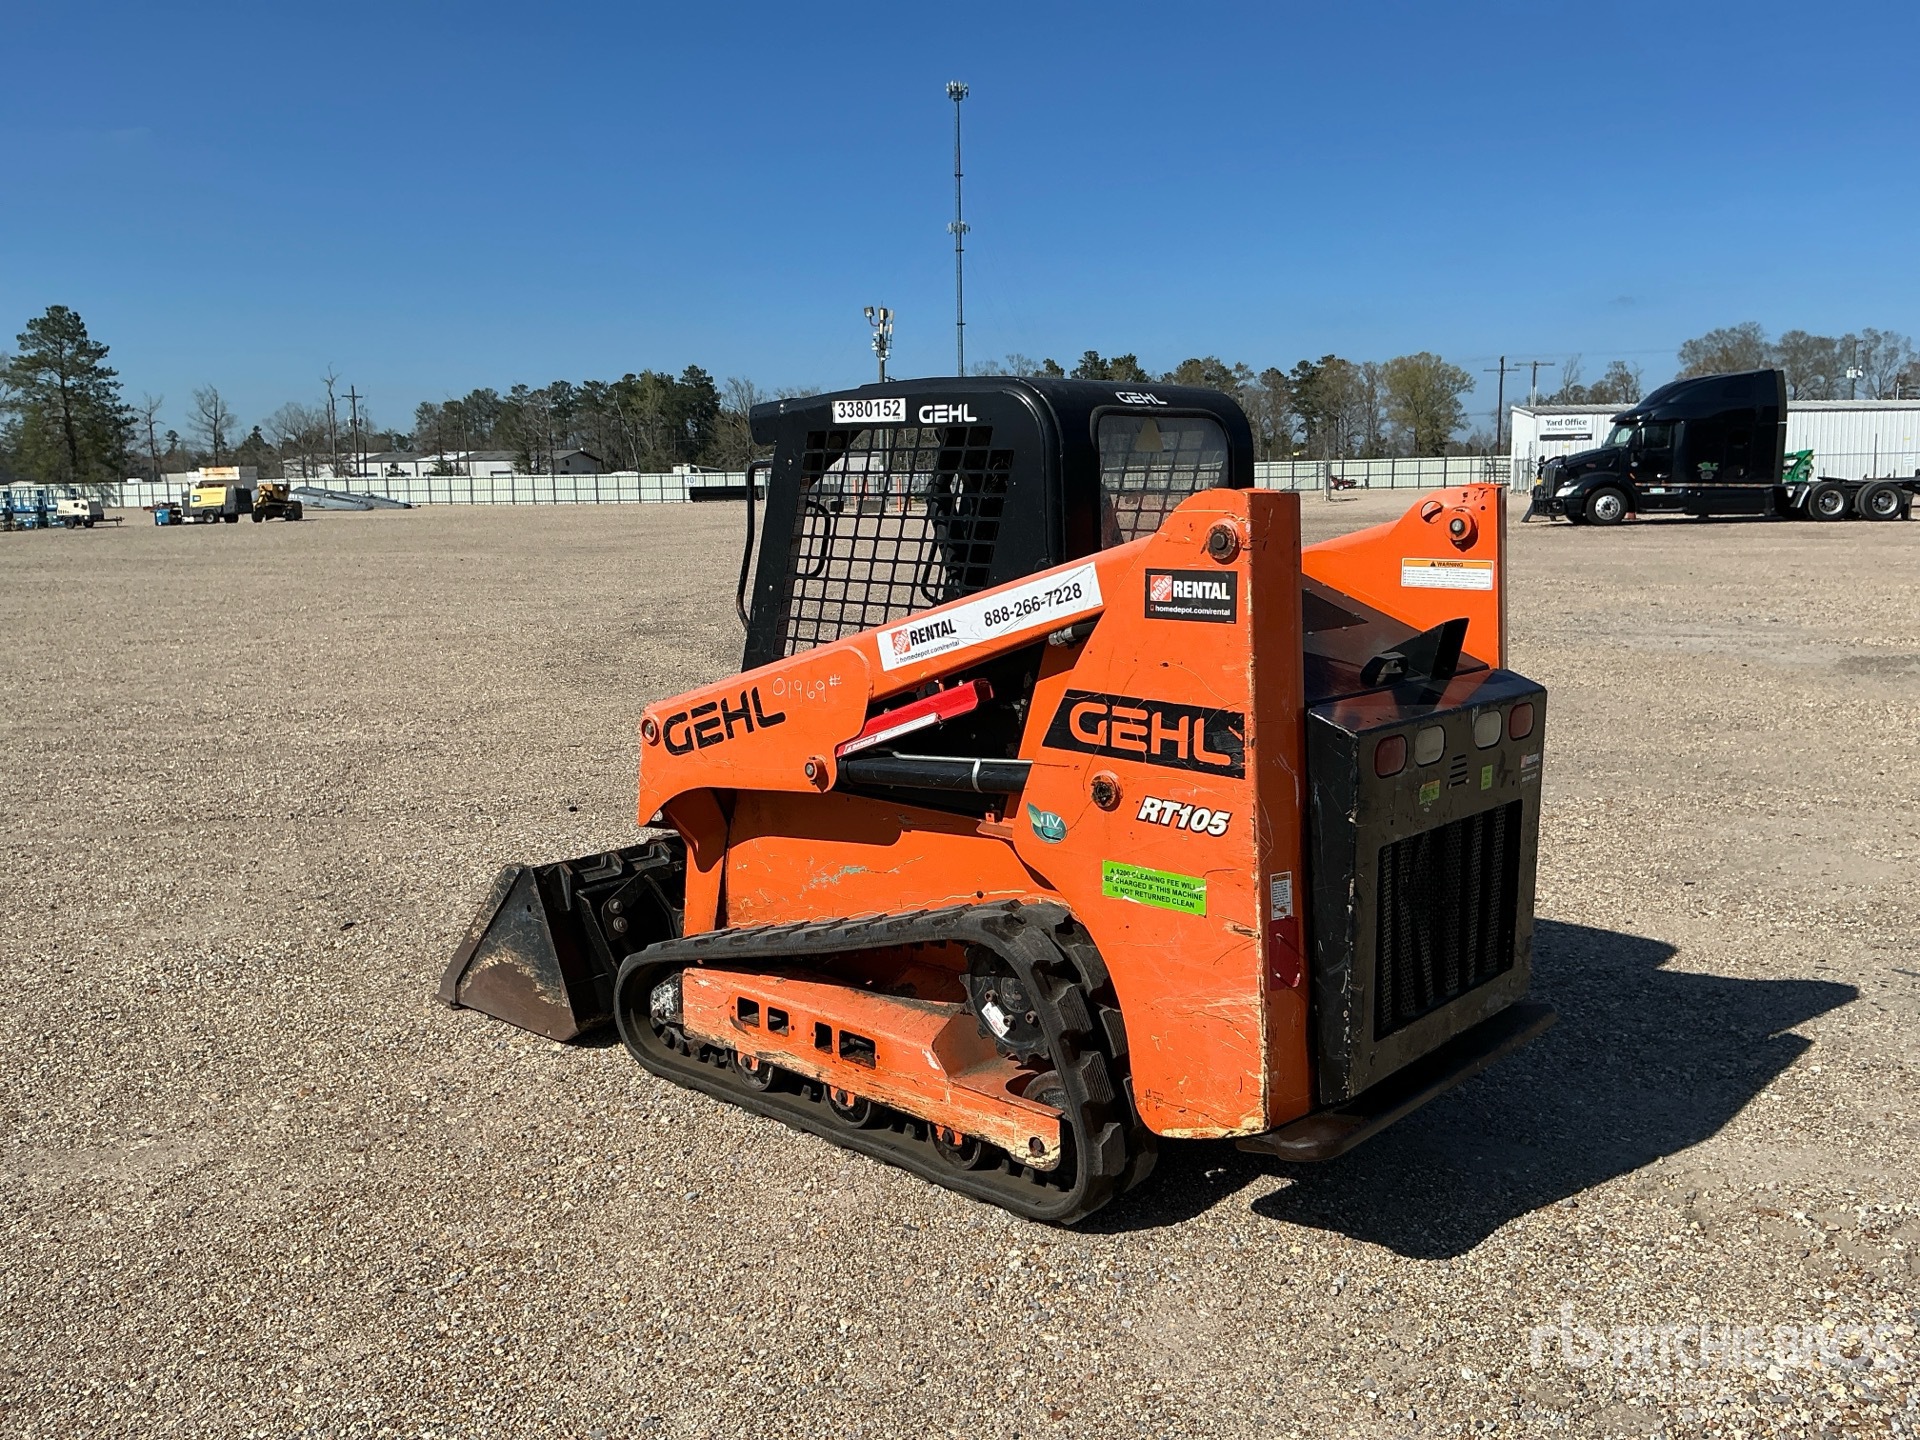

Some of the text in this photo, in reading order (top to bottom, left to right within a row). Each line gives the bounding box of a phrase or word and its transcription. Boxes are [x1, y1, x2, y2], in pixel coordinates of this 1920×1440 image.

[1115, 391, 1168, 405] GEHL
[838, 400, 901, 418] 3380152
[918, 403, 978, 423] GEHL
[1565, 418, 1587, 426] Office
[1437, 560, 1464, 568] WARNING
[1173, 580, 1231, 600] RENTAL
[983, 583, 1082, 627] 888-266-7228
[1155, 604, 1231, 616] homedepot.com/rental
[910, 618, 957, 646] RENTAL
[899, 640, 960, 664] homedepot.com/rental
[663, 686, 786, 757] GEHL
[1069, 701, 1232, 766] GEHL
[1137, 796, 1231, 837] RT105
[1115, 877, 1147, 890] CHARGED
[1156, 885, 1171, 895] THIS
[1172, 889, 1203, 901] MACHINE
[1132, 871, 1165, 885] CLEANING
[1167, 879, 1180, 888] FEE
[1181, 882, 1196, 891] WILL
[1120, 887, 1133, 895] NOT
[1134, 890, 1171, 903] RETURNED
[1172, 897, 1195, 908] CLEAN
